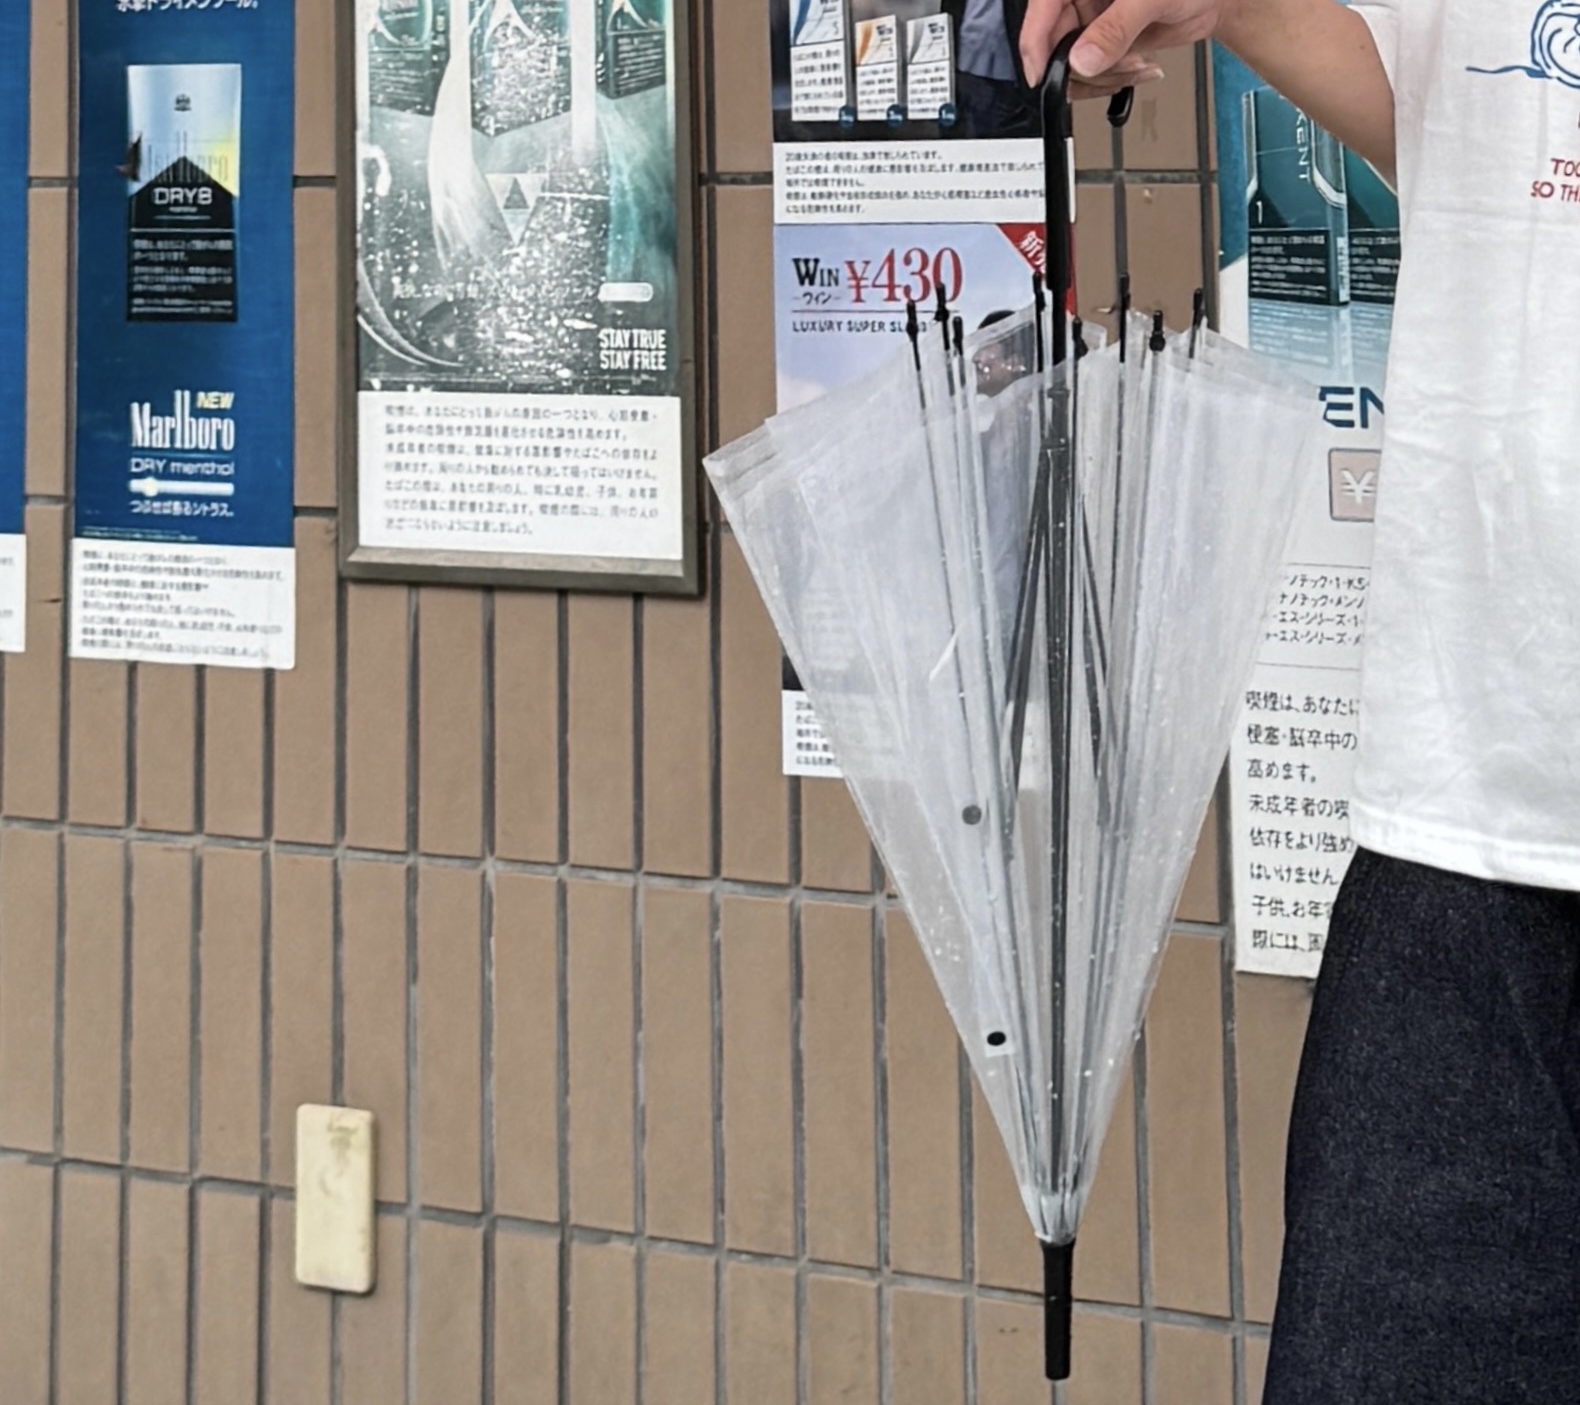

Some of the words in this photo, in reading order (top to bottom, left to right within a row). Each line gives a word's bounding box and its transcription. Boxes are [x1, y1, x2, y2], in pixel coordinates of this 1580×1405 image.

[1531, 180, 1555, 198] SO
[844, 247, 963, 303] ¥430
[791, 320, 842, 333] LUXURY
[846, 319, 886, 333] SUPER
[599, 329, 632, 349] STAY
[633, 329, 667, 349] TRUE
[599, 350, 632, 370] STAY
[633, 351, 667, 371] FREE
[130, 389, 235, 451] Marlboro
